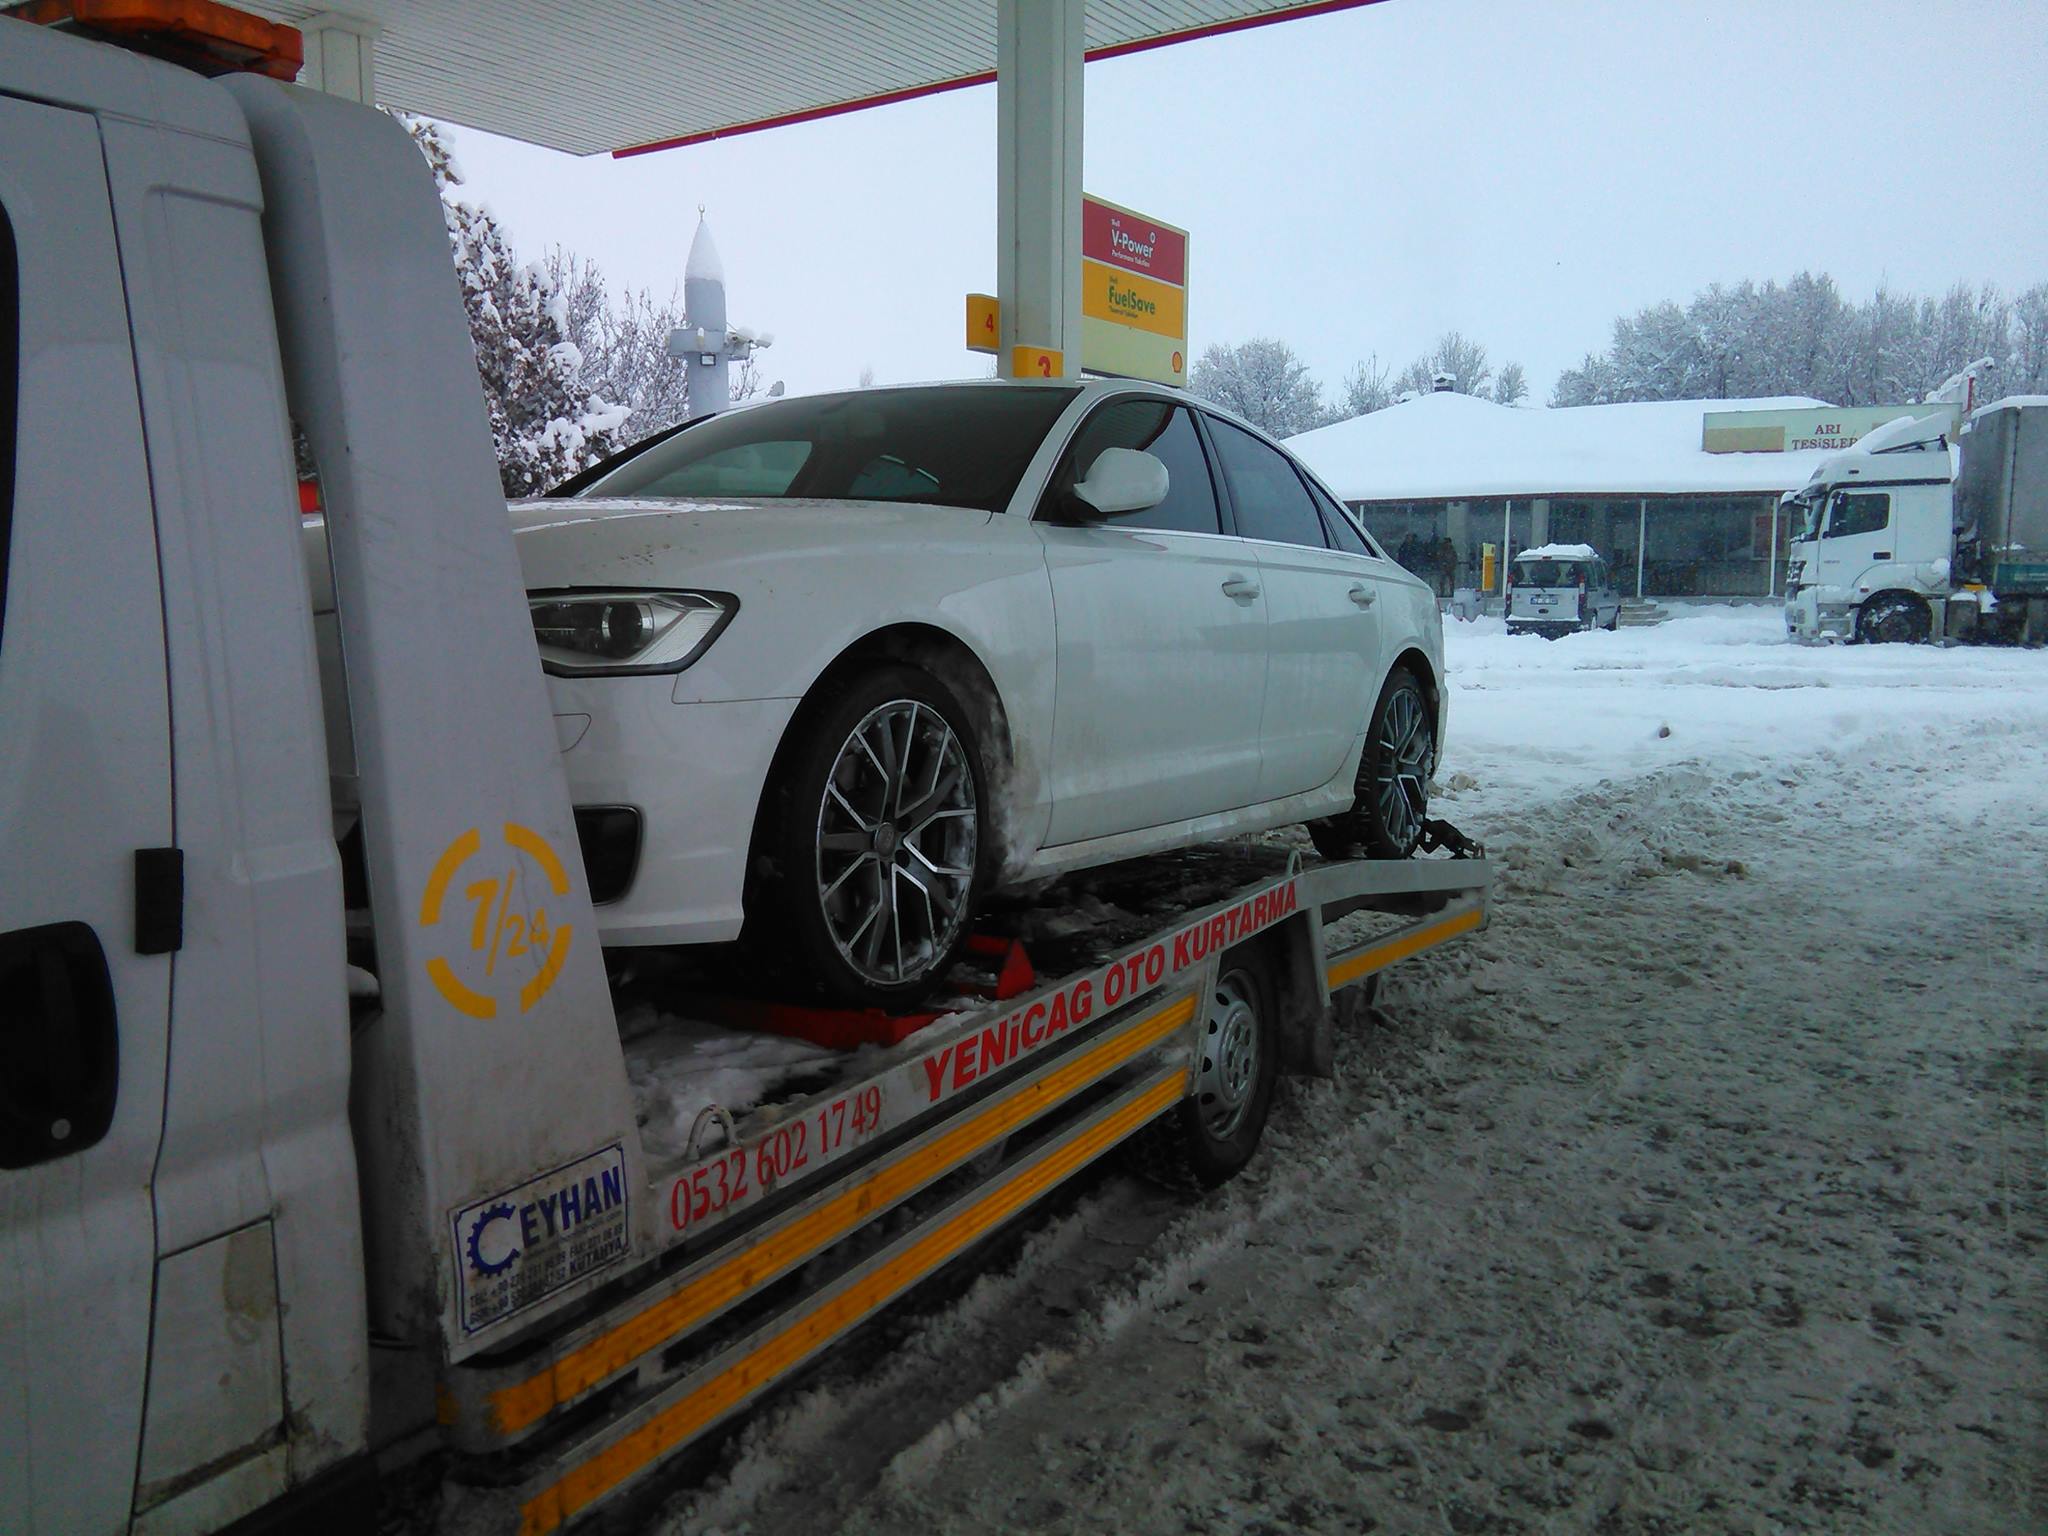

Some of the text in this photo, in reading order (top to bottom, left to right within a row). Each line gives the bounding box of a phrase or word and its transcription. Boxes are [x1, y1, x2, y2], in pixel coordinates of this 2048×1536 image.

[1111, 229, 1153, 258] V-Power
[1108, 286, 1156, 315] FuelSave
[985, 313, 994, 333] 4
[1814, 424, 1841, 435] ARI
[1104, 944, 1165, 1006] OTO
[1172, 880, 1298, 973] KURTARMA
[671, 1085, 883, 1231] 0532 602 1749
